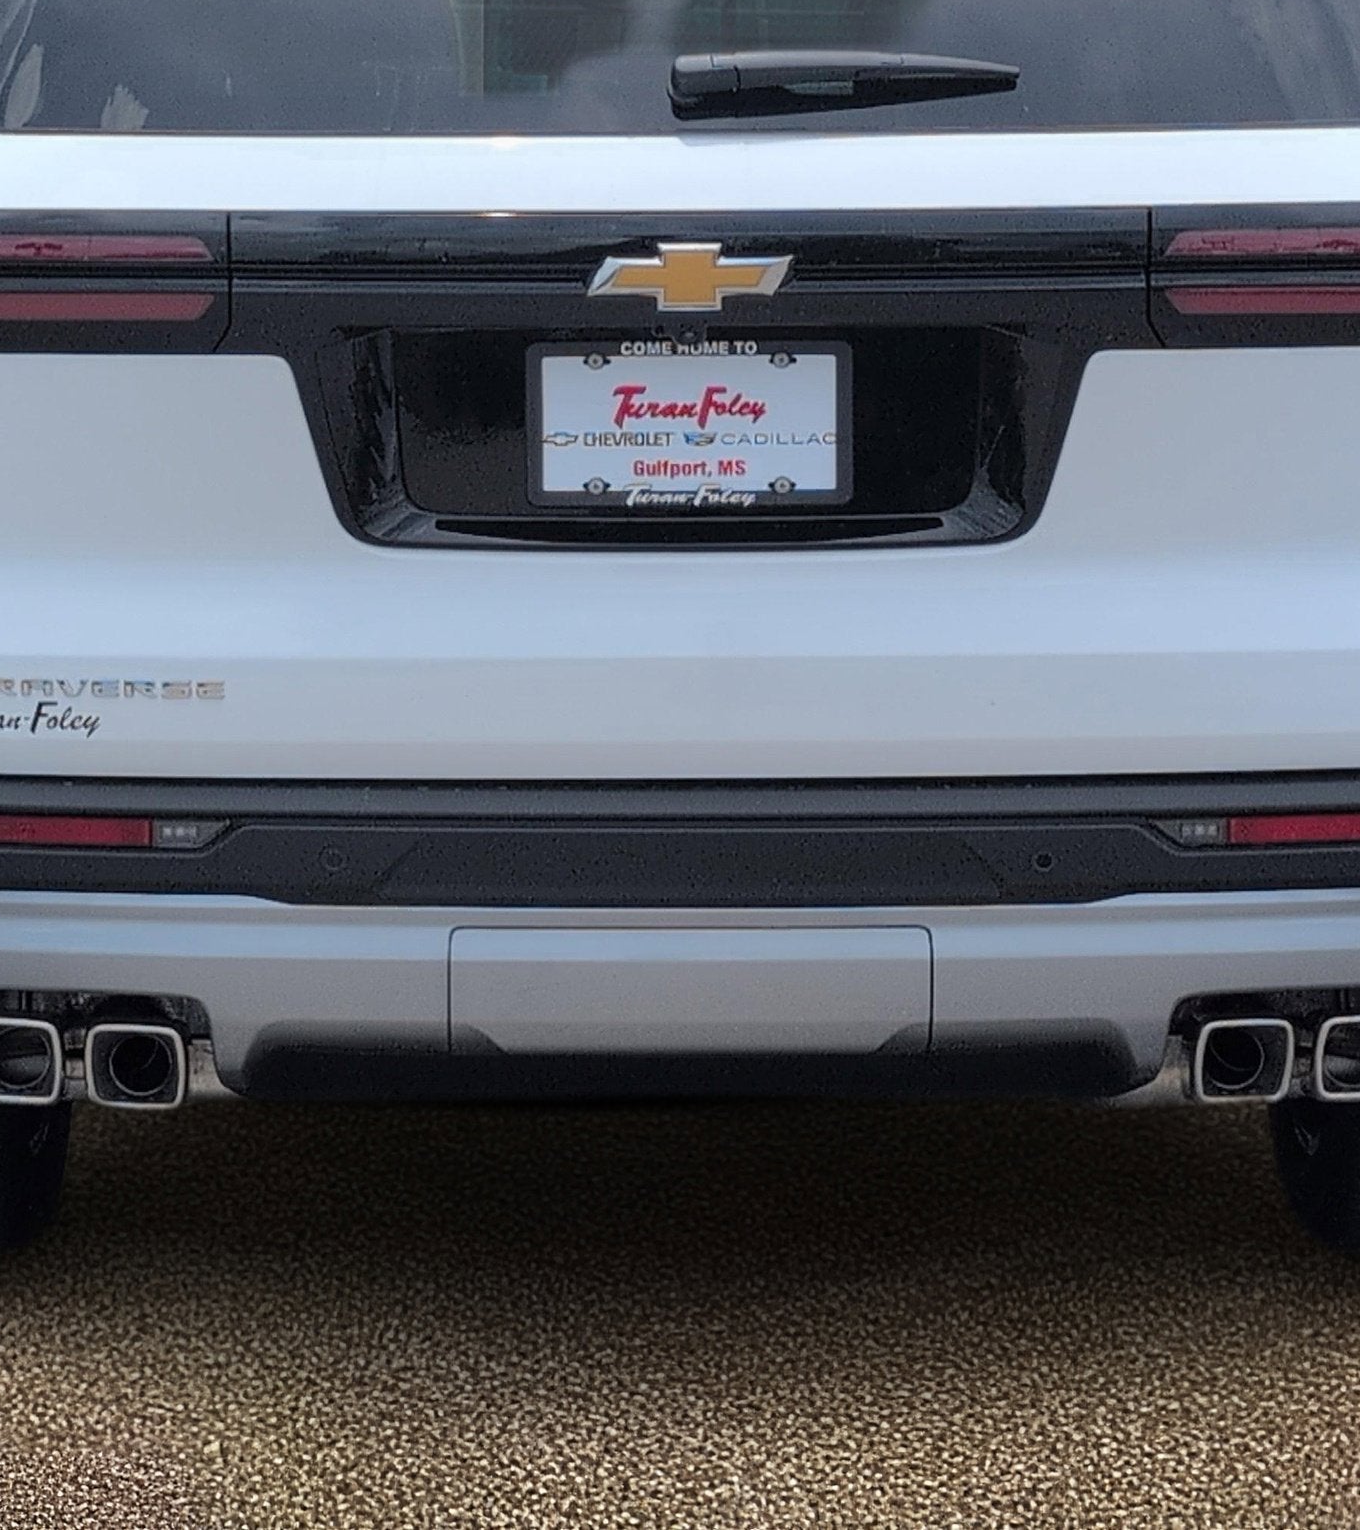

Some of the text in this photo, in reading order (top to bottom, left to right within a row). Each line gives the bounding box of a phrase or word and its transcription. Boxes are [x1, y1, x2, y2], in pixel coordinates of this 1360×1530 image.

[620, 341, 672, 355] COME
[733, 341, 758, 355] TO
[583, 431, 674, 447] CHEVROLET
[721, 432, 837, 446] CADILLAC
[633, 460, 746, 479] Gulfport, MS
